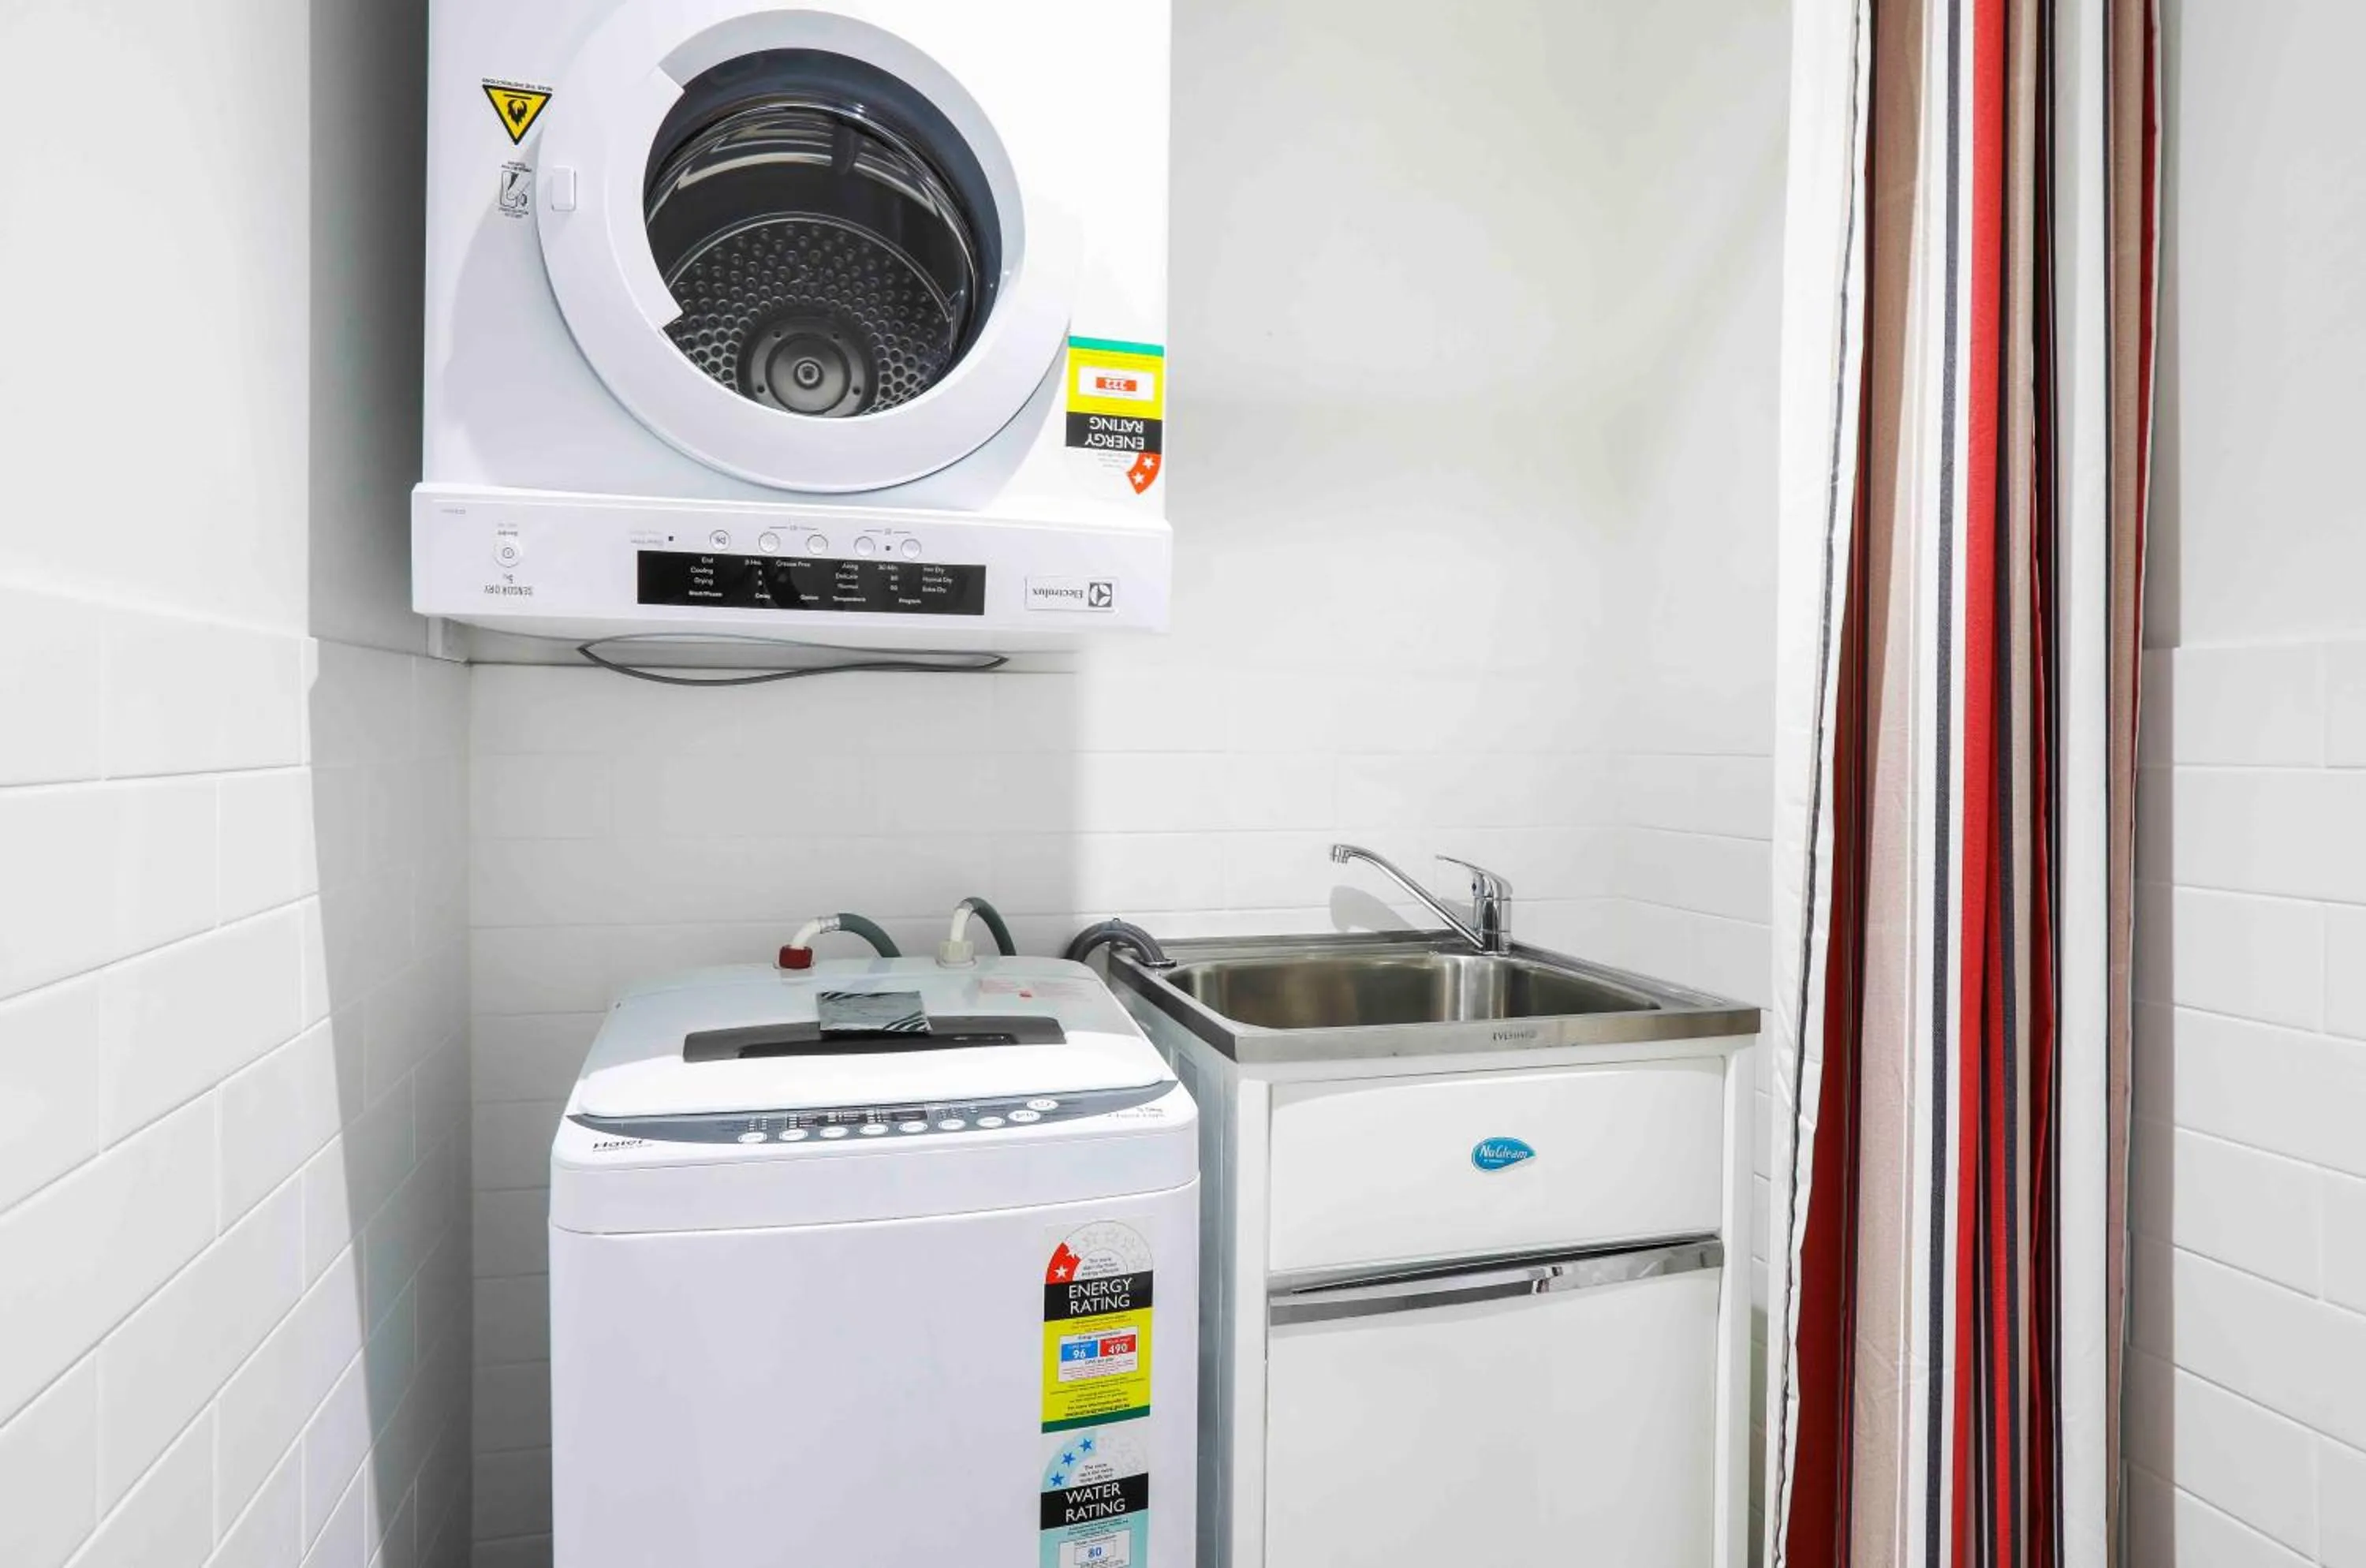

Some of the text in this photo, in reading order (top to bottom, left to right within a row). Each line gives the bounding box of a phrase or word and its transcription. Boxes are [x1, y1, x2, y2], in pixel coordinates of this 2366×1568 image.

[1089, 416, 1144, 434] RATING
[1084, 433, 1144, 450] ENERGY
[484, 584, 533, 595] SENSOR DRY
[1032, 588, 1084, 599] Electrolux
[593, 1139, 643, 1149] Haier
[1069, 1277, 1133, 1299] ENERGY
[1069, 1294, 1130, 1316] RATING
[1073, 1349, 1086, 1359] 96
[1108, 1343, 1128, 1354] 490
[1065, 1482, 1121, 1504] WATER
[1065, 1499, 1125, 1523] RATING
